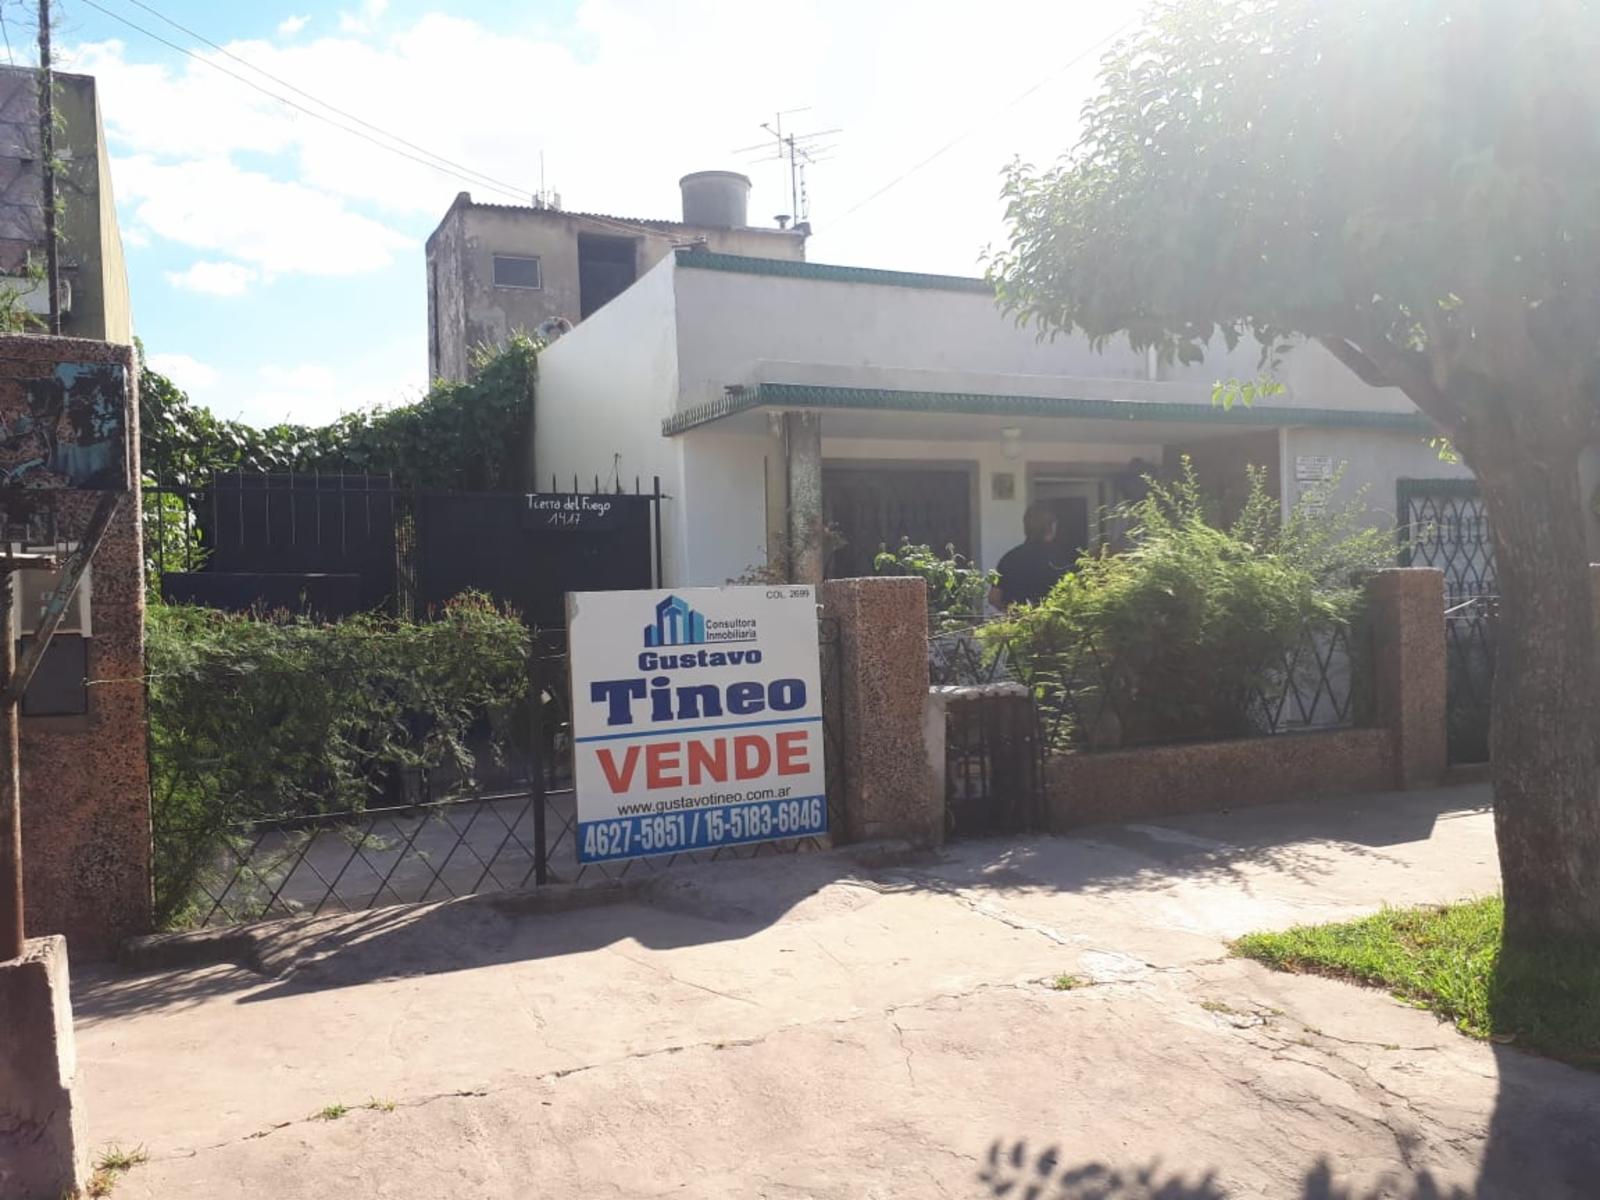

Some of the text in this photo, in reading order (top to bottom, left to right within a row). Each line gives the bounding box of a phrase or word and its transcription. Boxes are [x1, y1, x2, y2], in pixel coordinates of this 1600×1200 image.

[563, 496, 580, 510] del
[582, 496, 611, 517] Fuego
[706, 619, 757, 630] Consultora
[706, 629, 757, 640] Inmobiliaria
[638, 649, 762, 672] Gustavo
[590, 676, 807, 726] Tineo
[596, 730, 811, 794] VENDE
[617, 786, 791, 816] www.gustavotineo.com.ar
[584, 813, 686, 858] 4627-5851
[704, 798, 822, 843] 15-5183-6846
